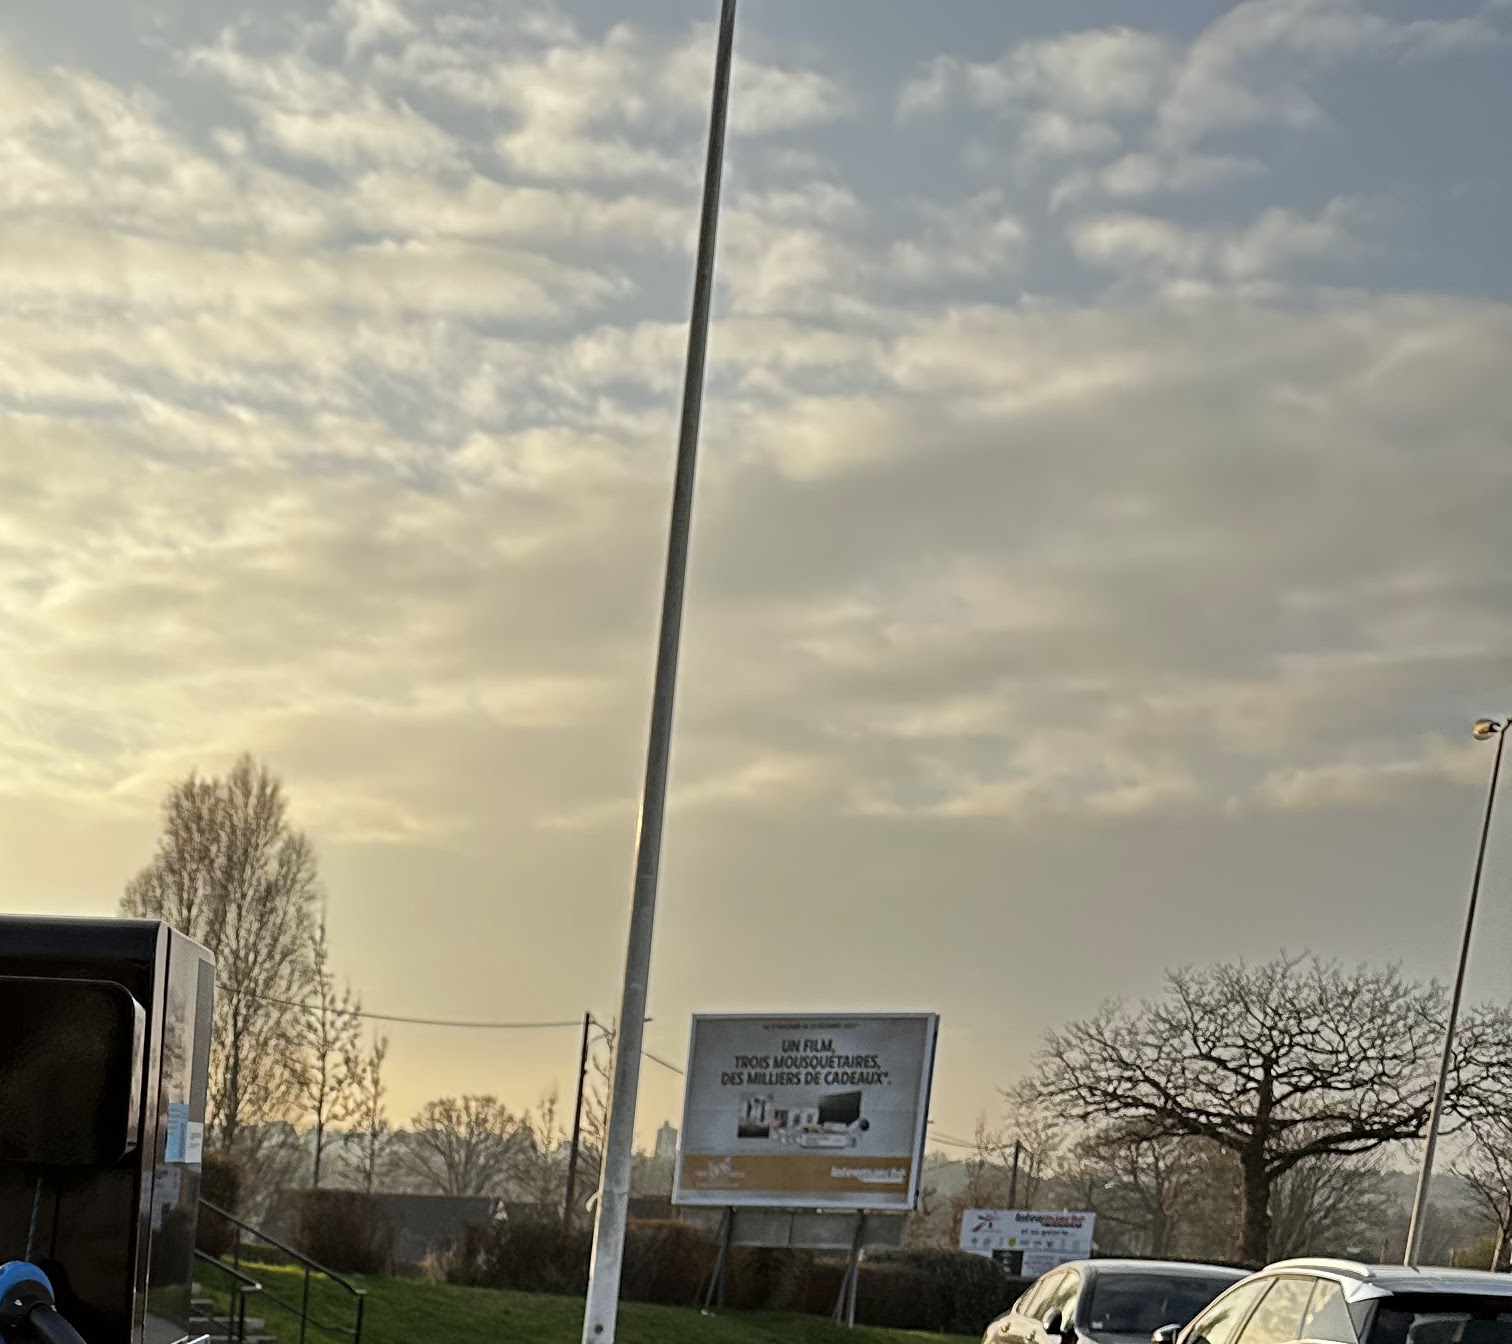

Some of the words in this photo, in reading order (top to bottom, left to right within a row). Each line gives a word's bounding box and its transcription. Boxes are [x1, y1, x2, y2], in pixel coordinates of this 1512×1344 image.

[781, 1038, 799, 1053] UN
[803, 1038, 836, 1055] FILM,
[734, 1055, 771, 1069] TROIS
[773, 1054, 882, 1070] MOUSQUETAIRES,
[721, 1071, 744, 1085] DES
[746, 1071, 801, 1085] MILLIERS
[803, 1072, 820, 1085] DE
